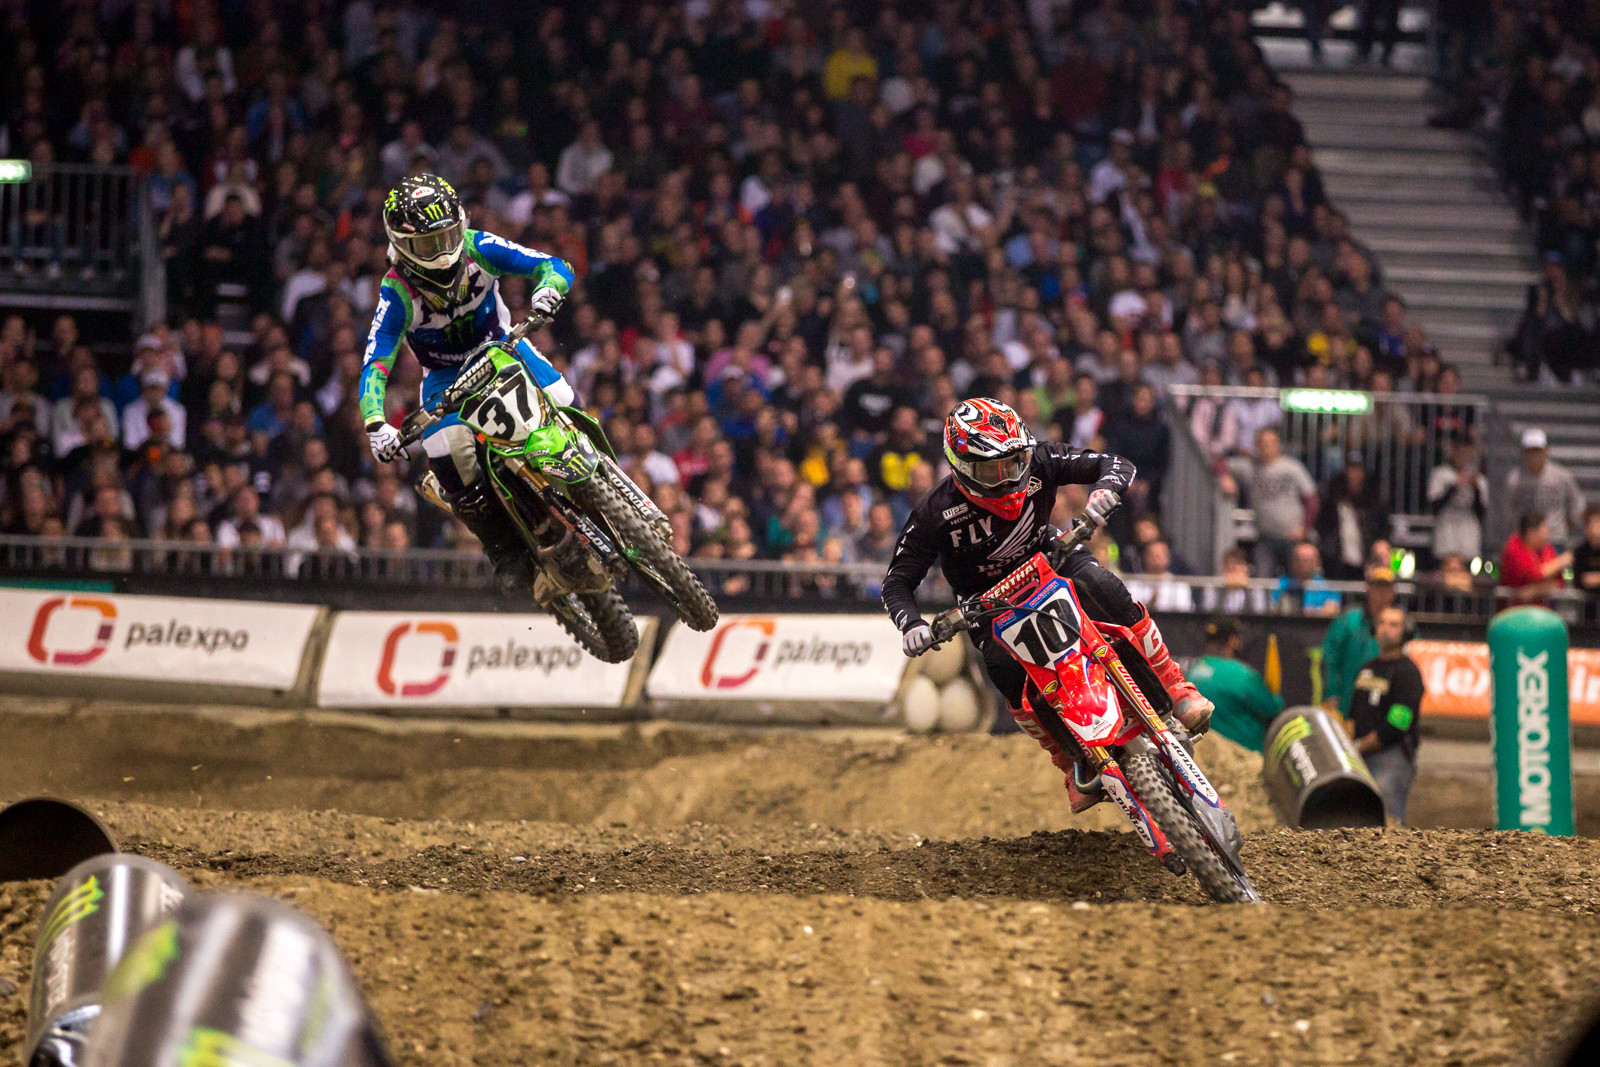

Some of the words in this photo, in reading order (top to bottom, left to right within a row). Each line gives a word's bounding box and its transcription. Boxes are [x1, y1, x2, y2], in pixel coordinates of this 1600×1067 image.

[478, 370, 534, 441] 37
[942, 503, 969, 520] WPS
[950, 515, 993, 548] FLY
[125, 617, 250, 653] palexpo
[773, 633, 873, 671] palexpo
[1012, 598, 1081, 668] 10
[466, 638, 583, 674] palexpo
[1516, 645, 1552, 827] MOTOREX
[1171, 741, 1207, 787] DUNLOP
[1116, 795, 1151, 843] DUNLOP
